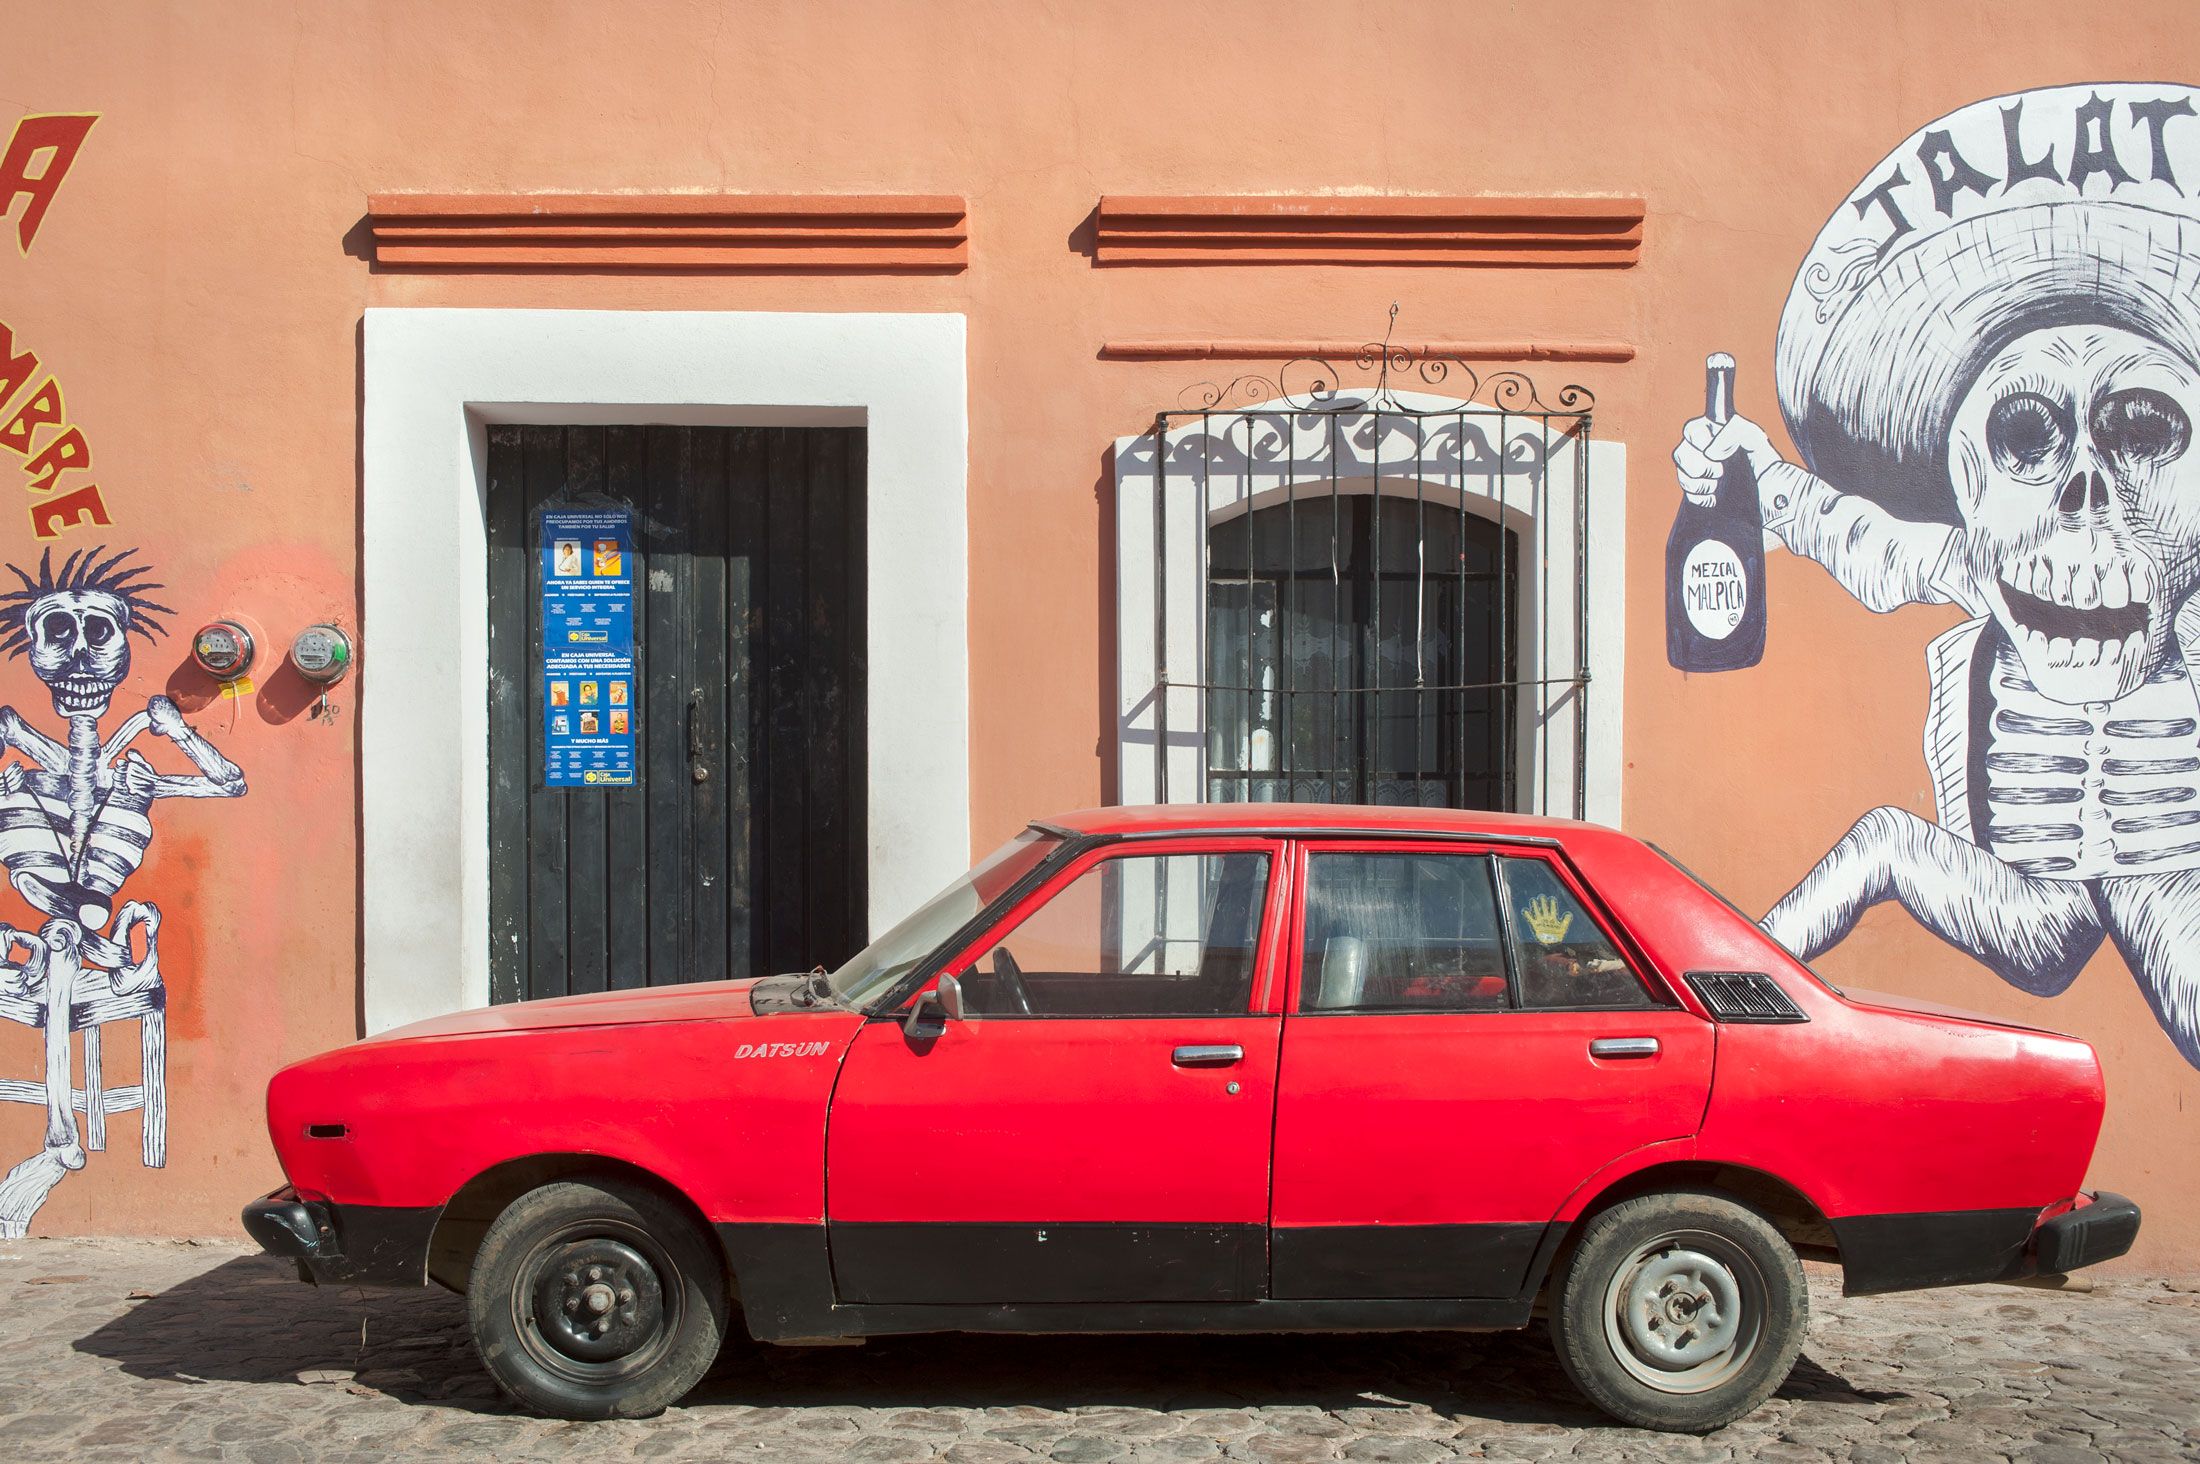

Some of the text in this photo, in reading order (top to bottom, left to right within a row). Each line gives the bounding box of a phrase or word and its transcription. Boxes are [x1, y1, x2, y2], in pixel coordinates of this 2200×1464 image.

[1692, 562, 1738, 578] MEZCAL
[1687, 580, 1745, 611] MALPICA
[734, 1041, 830, 1059] DATSUN
